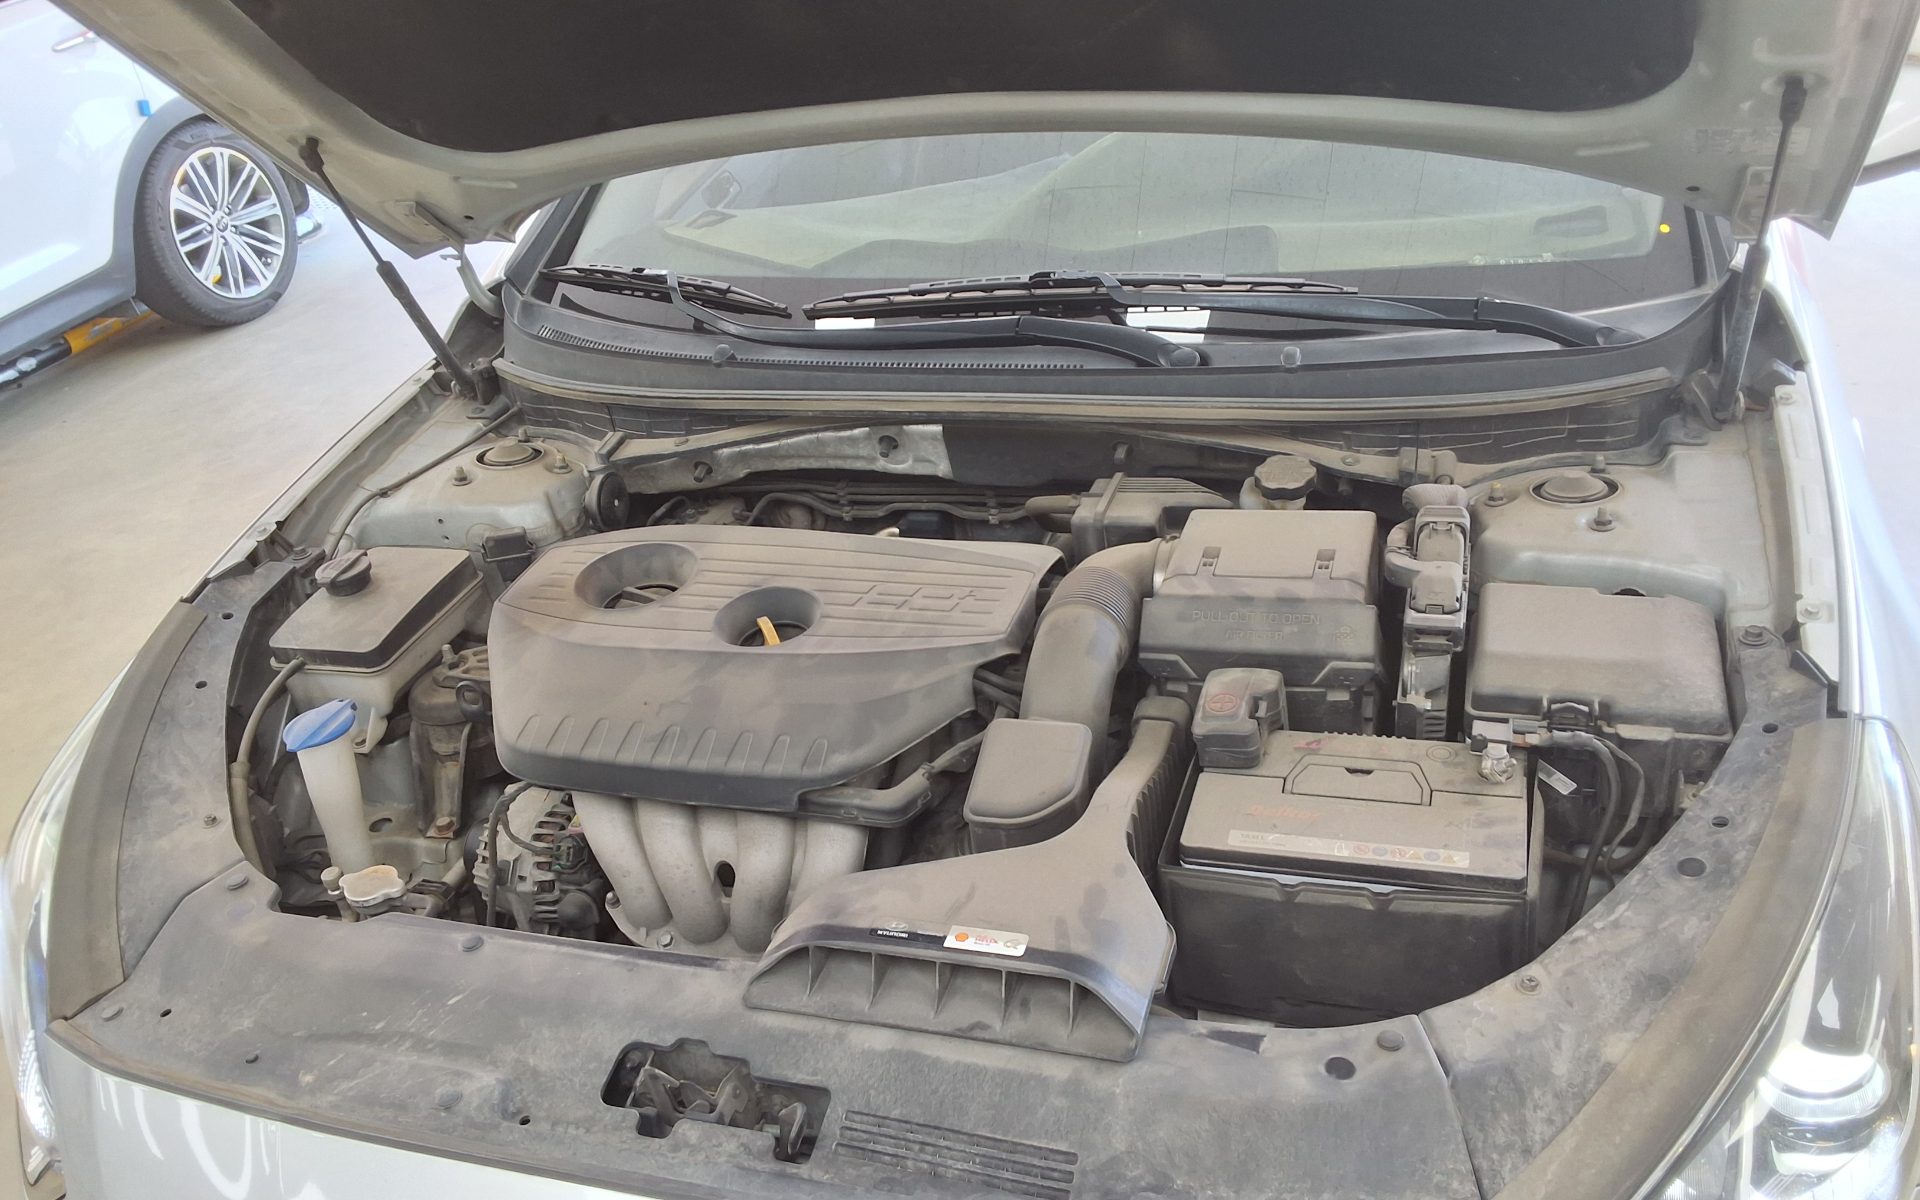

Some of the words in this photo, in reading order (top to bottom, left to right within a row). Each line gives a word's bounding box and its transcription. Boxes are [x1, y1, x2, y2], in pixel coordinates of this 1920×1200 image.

[1192, 610, 1226, 622] PULL
[1230, 611, 1257, 623] OUT
[1262, 612, 1279, 624] TO
[1282, 612, 1321, 625] OPEN
[1225, 629, 1243, 640] AIR
[1247, 630, 1284, 641] FILTER
[877, 930, 908, 938] HYUNDAI
